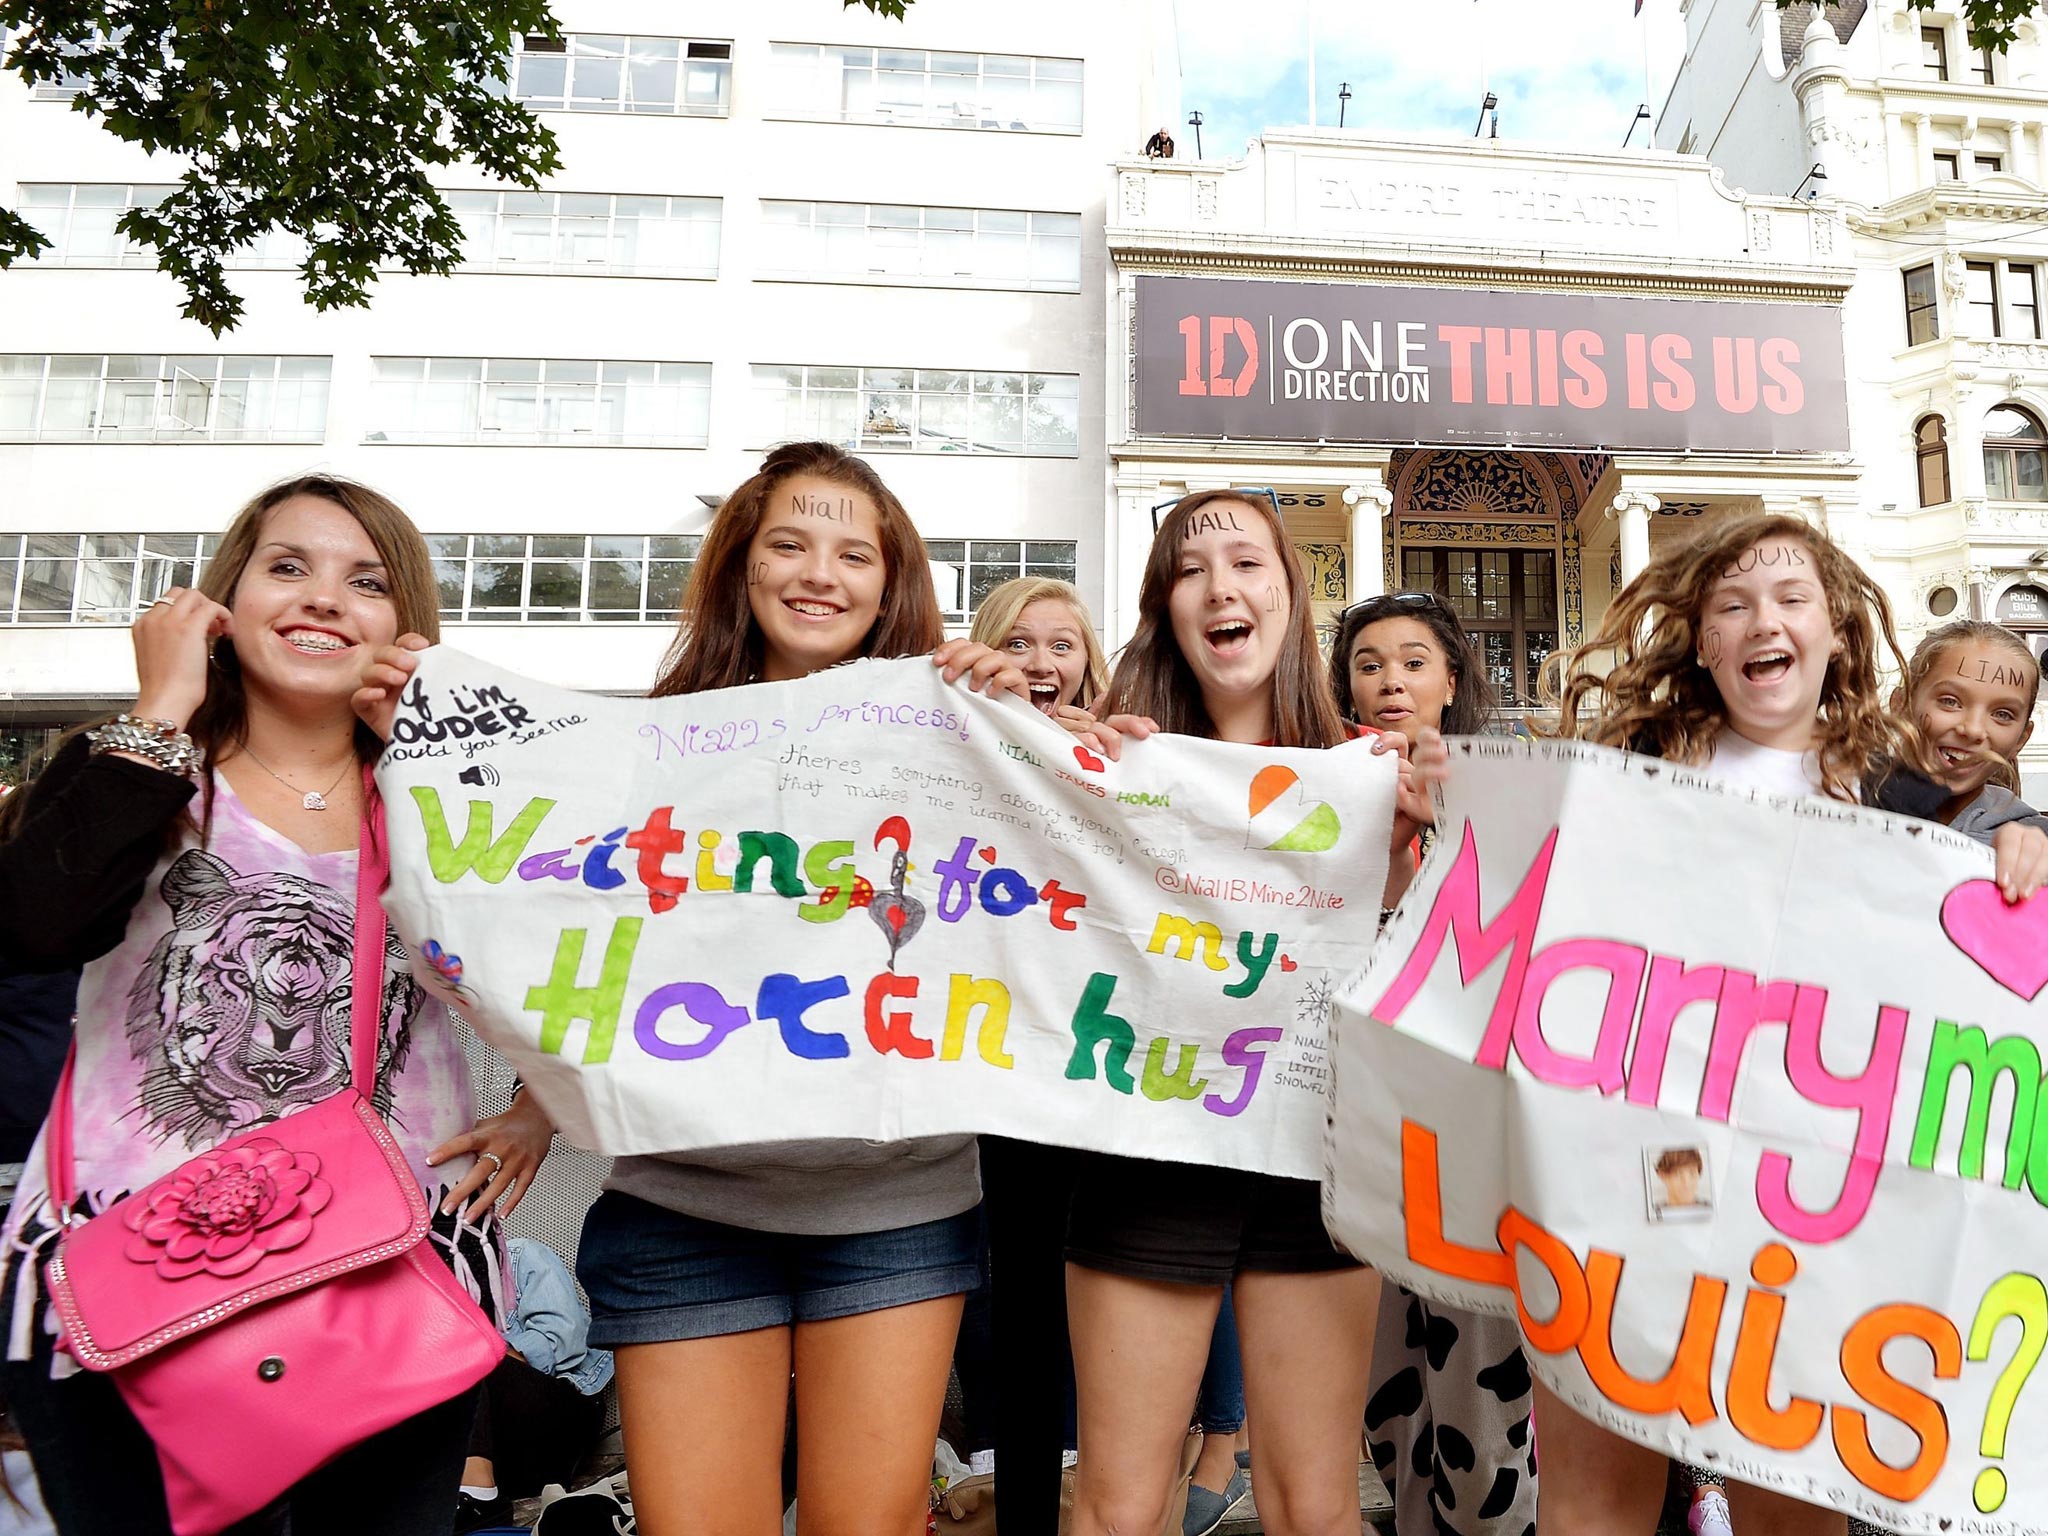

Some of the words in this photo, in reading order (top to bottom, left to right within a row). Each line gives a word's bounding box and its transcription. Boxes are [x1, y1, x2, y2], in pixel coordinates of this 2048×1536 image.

[1319, 178, 1463, 217] EMPIRE
[1491, 189, 1660, 228] THEATRE
[1179, 315, 1259, 397] 1D
[1283, 318, 1429, 374] ONE
[1284, 369, 1430, 403] DIRECTION
[1438, 325, 1608, 409] THIS
[1625, 333, 1697, 412] IS
[1712, 337, 1805, 415] US
[792, 495, 854, 525] Niall
[750, 562, 770, 585] 1D
[1722, 547, 1805, 578] LOUIS
[2010, 592, 2038, 603] Ruby
[2012, 602, 2038, 611] Blue
[1957, 656, 2025, 688] LIAM
[385, 705, 536, 747] OUDER
[460, 738, 500, 759] you
[779, 744, 863, 775] theres
[1000, 790, 1063, 824] about
[999, 741, 1047, 770] NIALL
[1054, 768, 1107, 799] JAMES
[1116, 791, 1171, 808] HORAN
[778, 772, 824, 798] that
[844, 781, 910, 804] makes
[927, 794, 955, 811] me
[968, 805, 1032, 831] wanna
[1043, 823, 1087, 846] have
[409, 786, 856, 923] Waiting
[933, 836, 1087, 931] for
[1146, 912, 1280, 998] my
[523, 916, 1014, 1070] Horan
[1064, 972, 1284, 1117] hug
[1370, 817, 1910, 1243] Marry
[1909, 1017, 2048, 1209] m
[1294, 1034, 1328, 1050] NIALL
